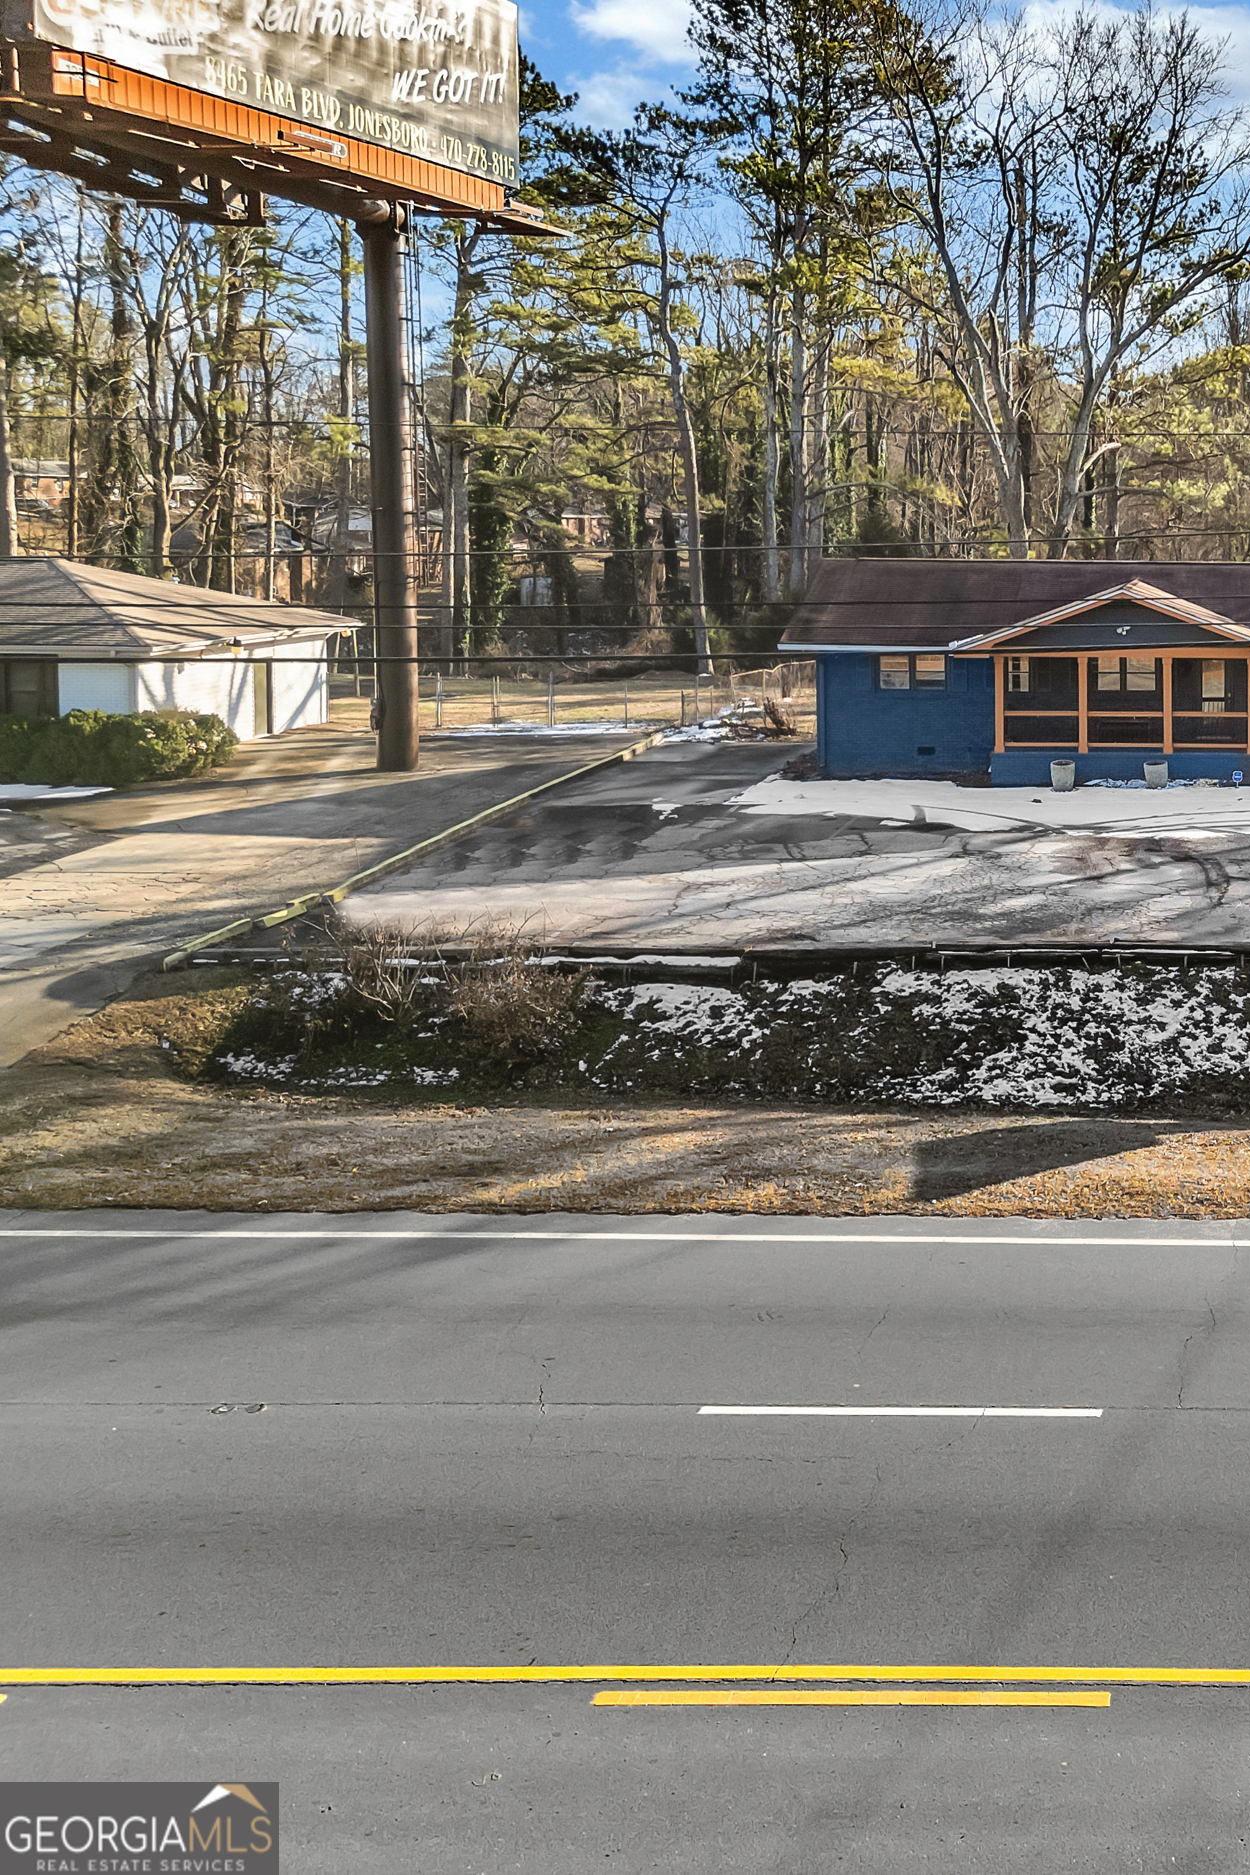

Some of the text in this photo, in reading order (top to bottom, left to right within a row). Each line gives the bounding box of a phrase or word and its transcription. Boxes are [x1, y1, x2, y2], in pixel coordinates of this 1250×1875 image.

[246, 0, 304, 34] Real
[308, 0, 375, 39] Home
[392, 68, 507, 104] WE GOT IT!
[204, 56, 248, 96] 8465
[252, 71, 297, 111] TARA
[348, 103, 429, 151] JONESBORO
[440, 134, 515, 181] 470-278-8115
